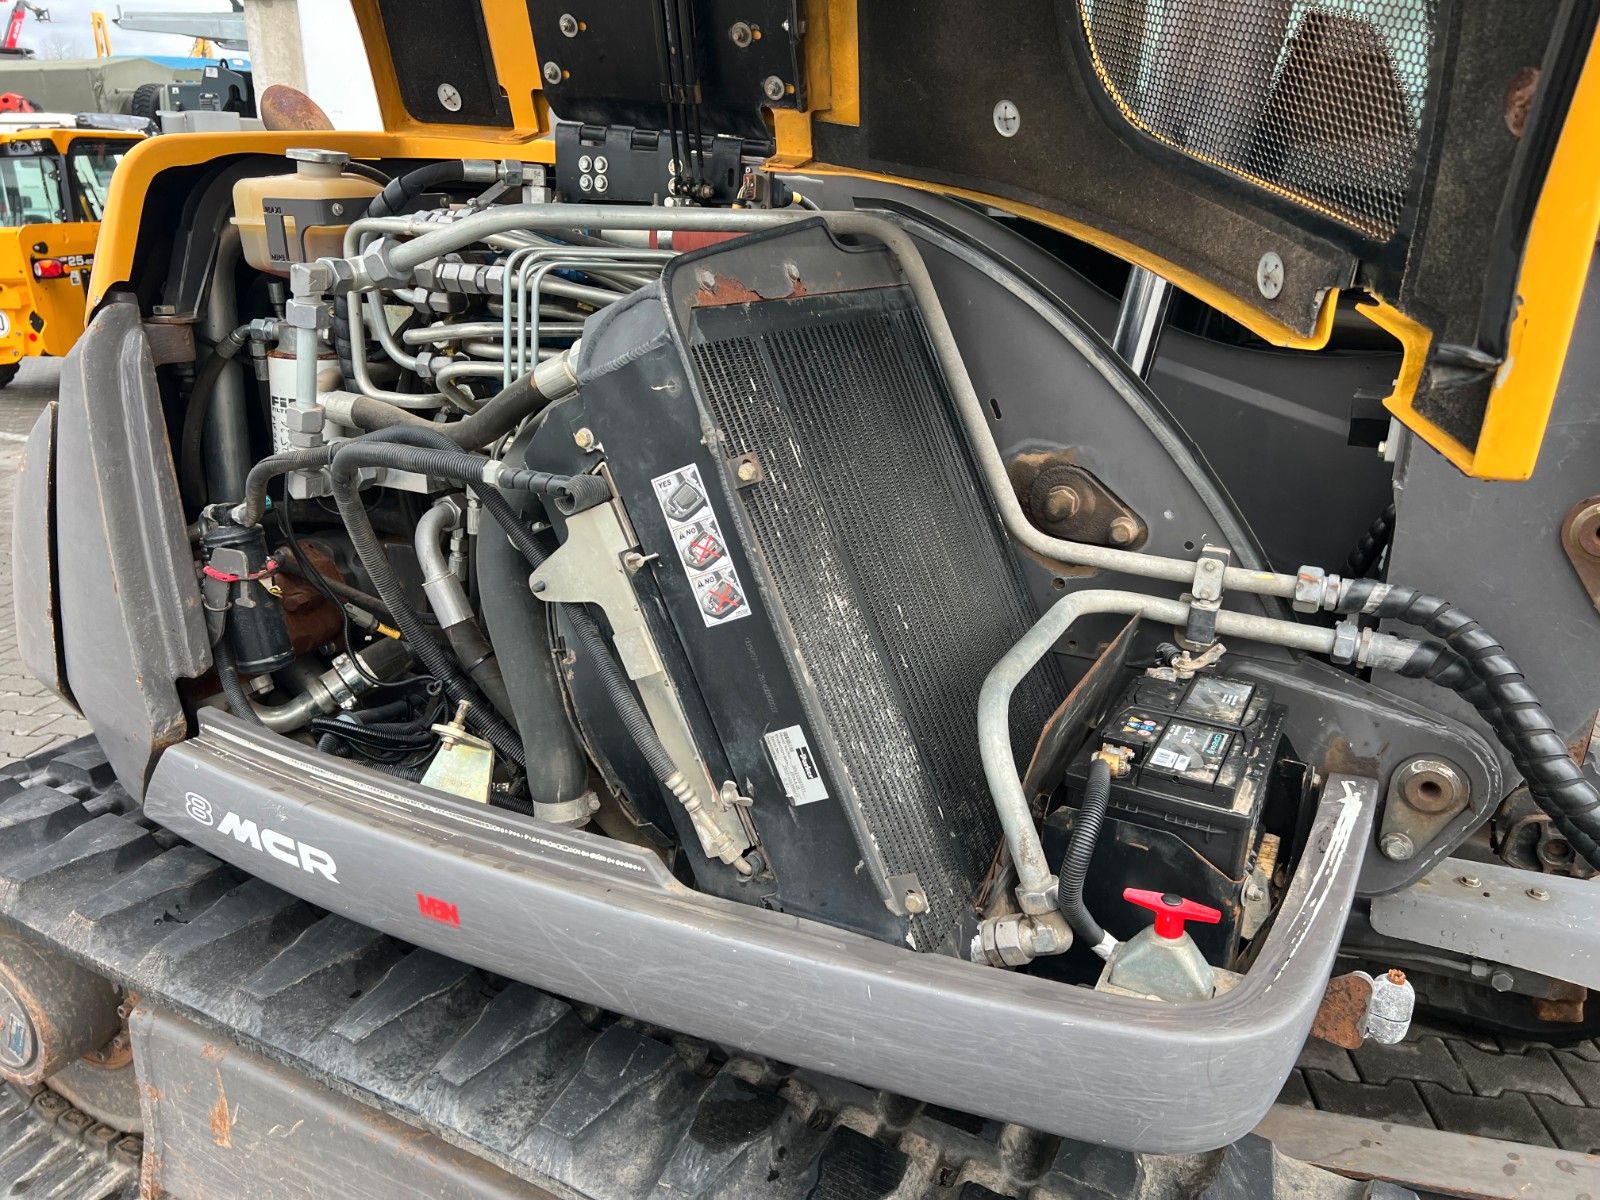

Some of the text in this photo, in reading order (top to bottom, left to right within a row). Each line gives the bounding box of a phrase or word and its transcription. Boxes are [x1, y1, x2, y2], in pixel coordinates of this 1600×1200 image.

[657, 479, 672, 489] YES
[686, 527, 696, 536] NO
[704, 576, 715, 585] NO
[799, 753, 814, 778] Parker
[185, 791, 341, 885] 8 MCR
